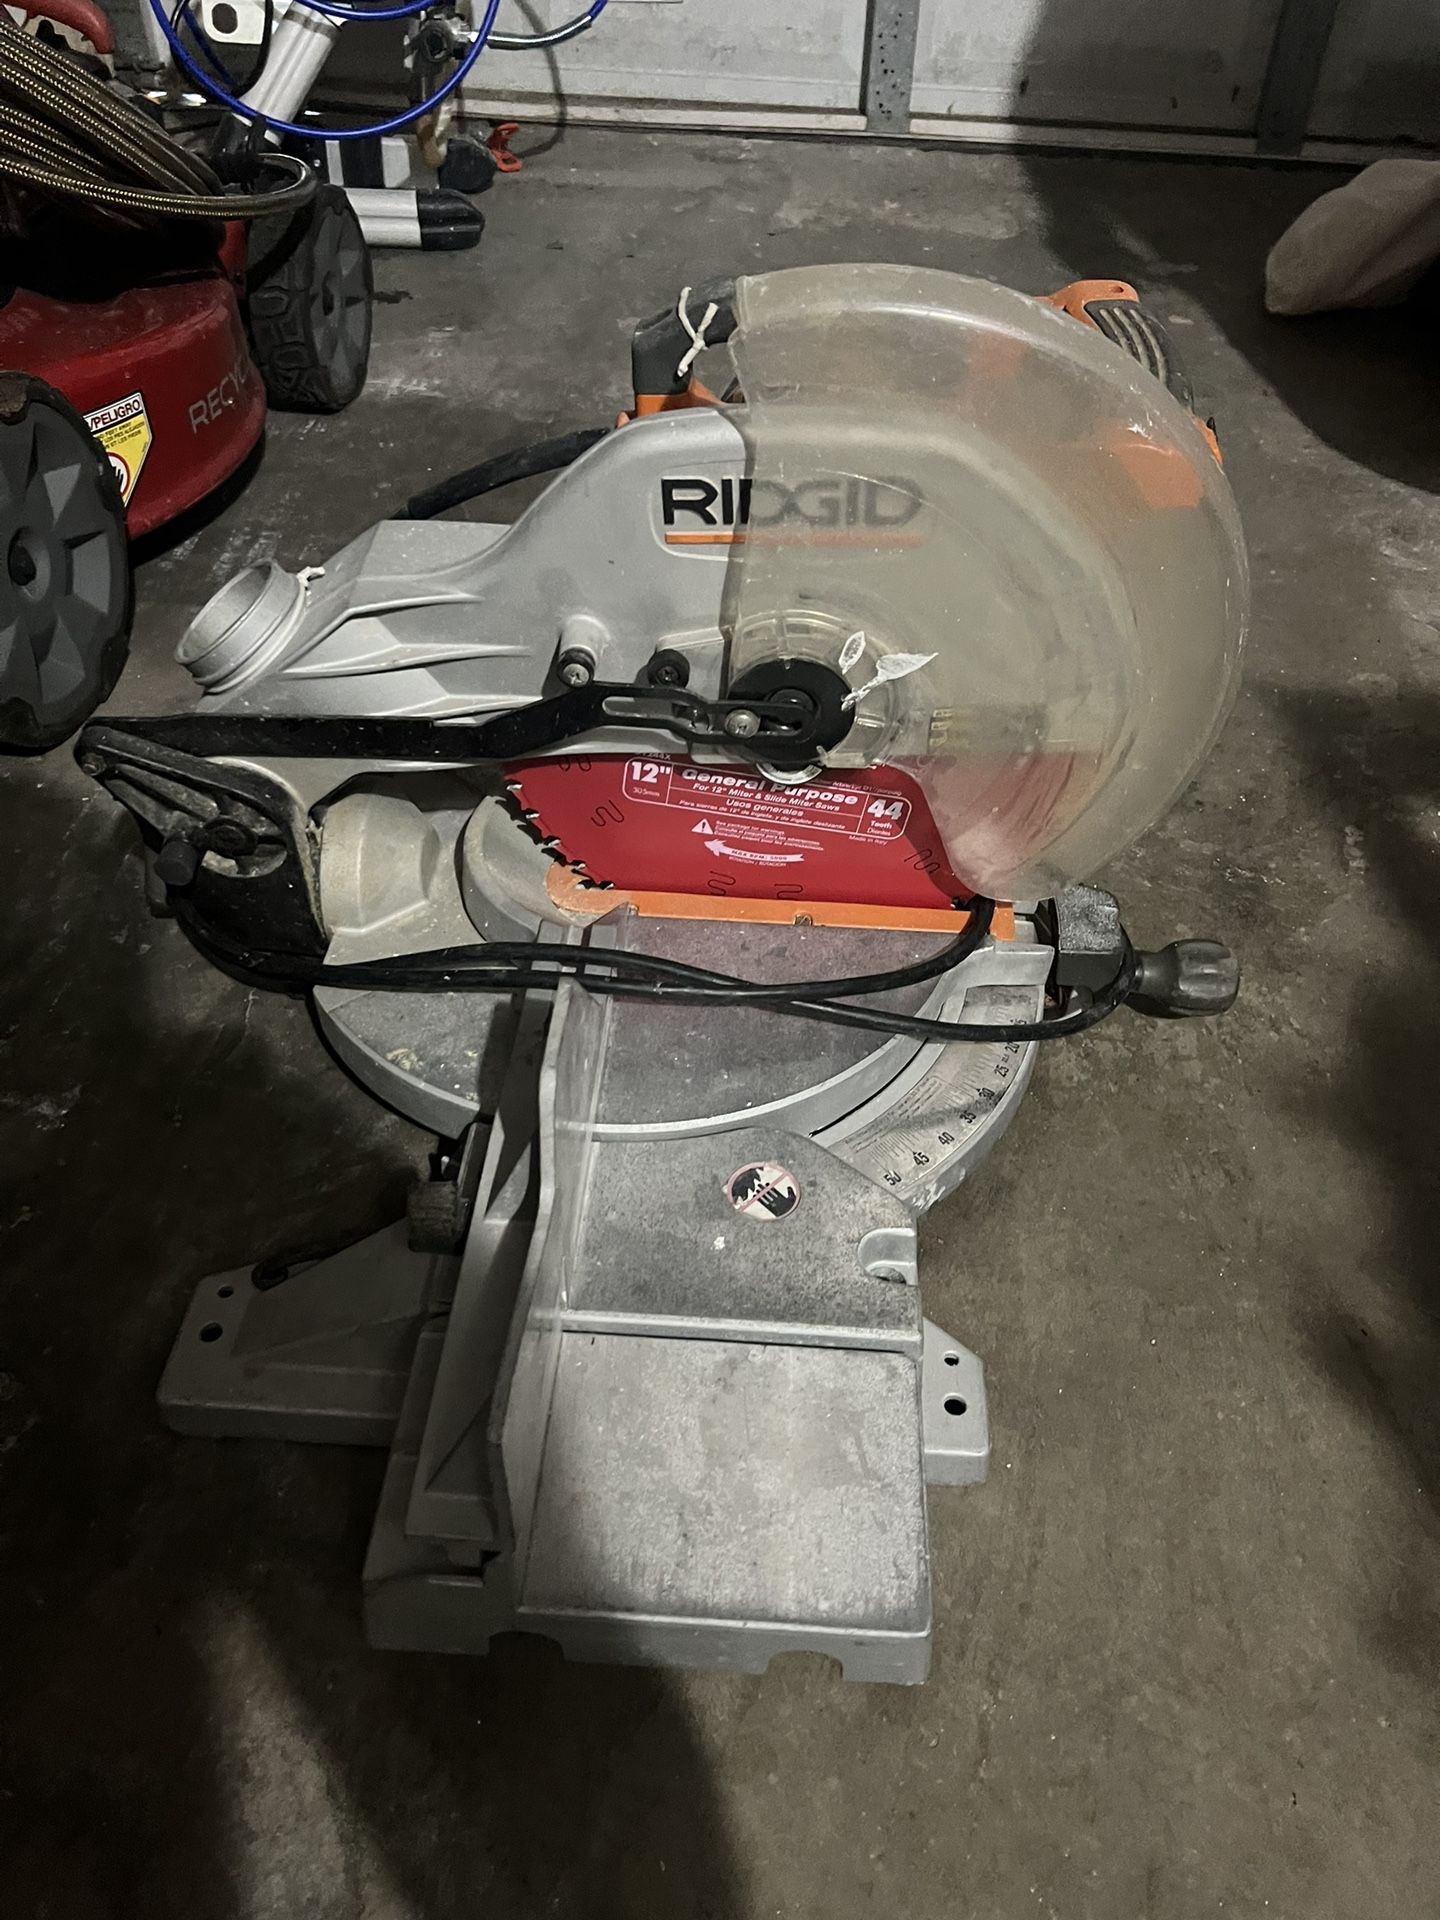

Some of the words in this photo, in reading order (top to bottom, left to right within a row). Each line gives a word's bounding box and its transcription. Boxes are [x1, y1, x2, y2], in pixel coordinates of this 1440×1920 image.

[661, 477, 925, 528] RIDGID
[631, 761, 671, 784] 12"
[682, 768, 766, 791] General
[771, 783, 859, 805] Purpose
[693, 783, 709, 792] For
[728, 788, 754, 798] Miter
[755, 792, 762, 800] &
[764, 794, 787, 804] Slide
[788, 797, 813, 807] Miter
[814, 802, 840, 812] Saws
[726, 798, 752, 809] Usos
[753, 802, 804, 817] generales
[867, 799, 904, 821] 44
[867, 827, 892, 836] Dientes
[870, 820, 893, 829] Teeth
[1005, 1042, 1020, 1054] 20
[994, 1065, 1009, 1078] 25
[979, 1087, 995, 1100] 30
[960, 1110, 977, 1124] 35
[938, 1131, 955, 1145] 40
[913, 1152, 930, 1166] 45
[884, 1170, 902, 1186] 50
